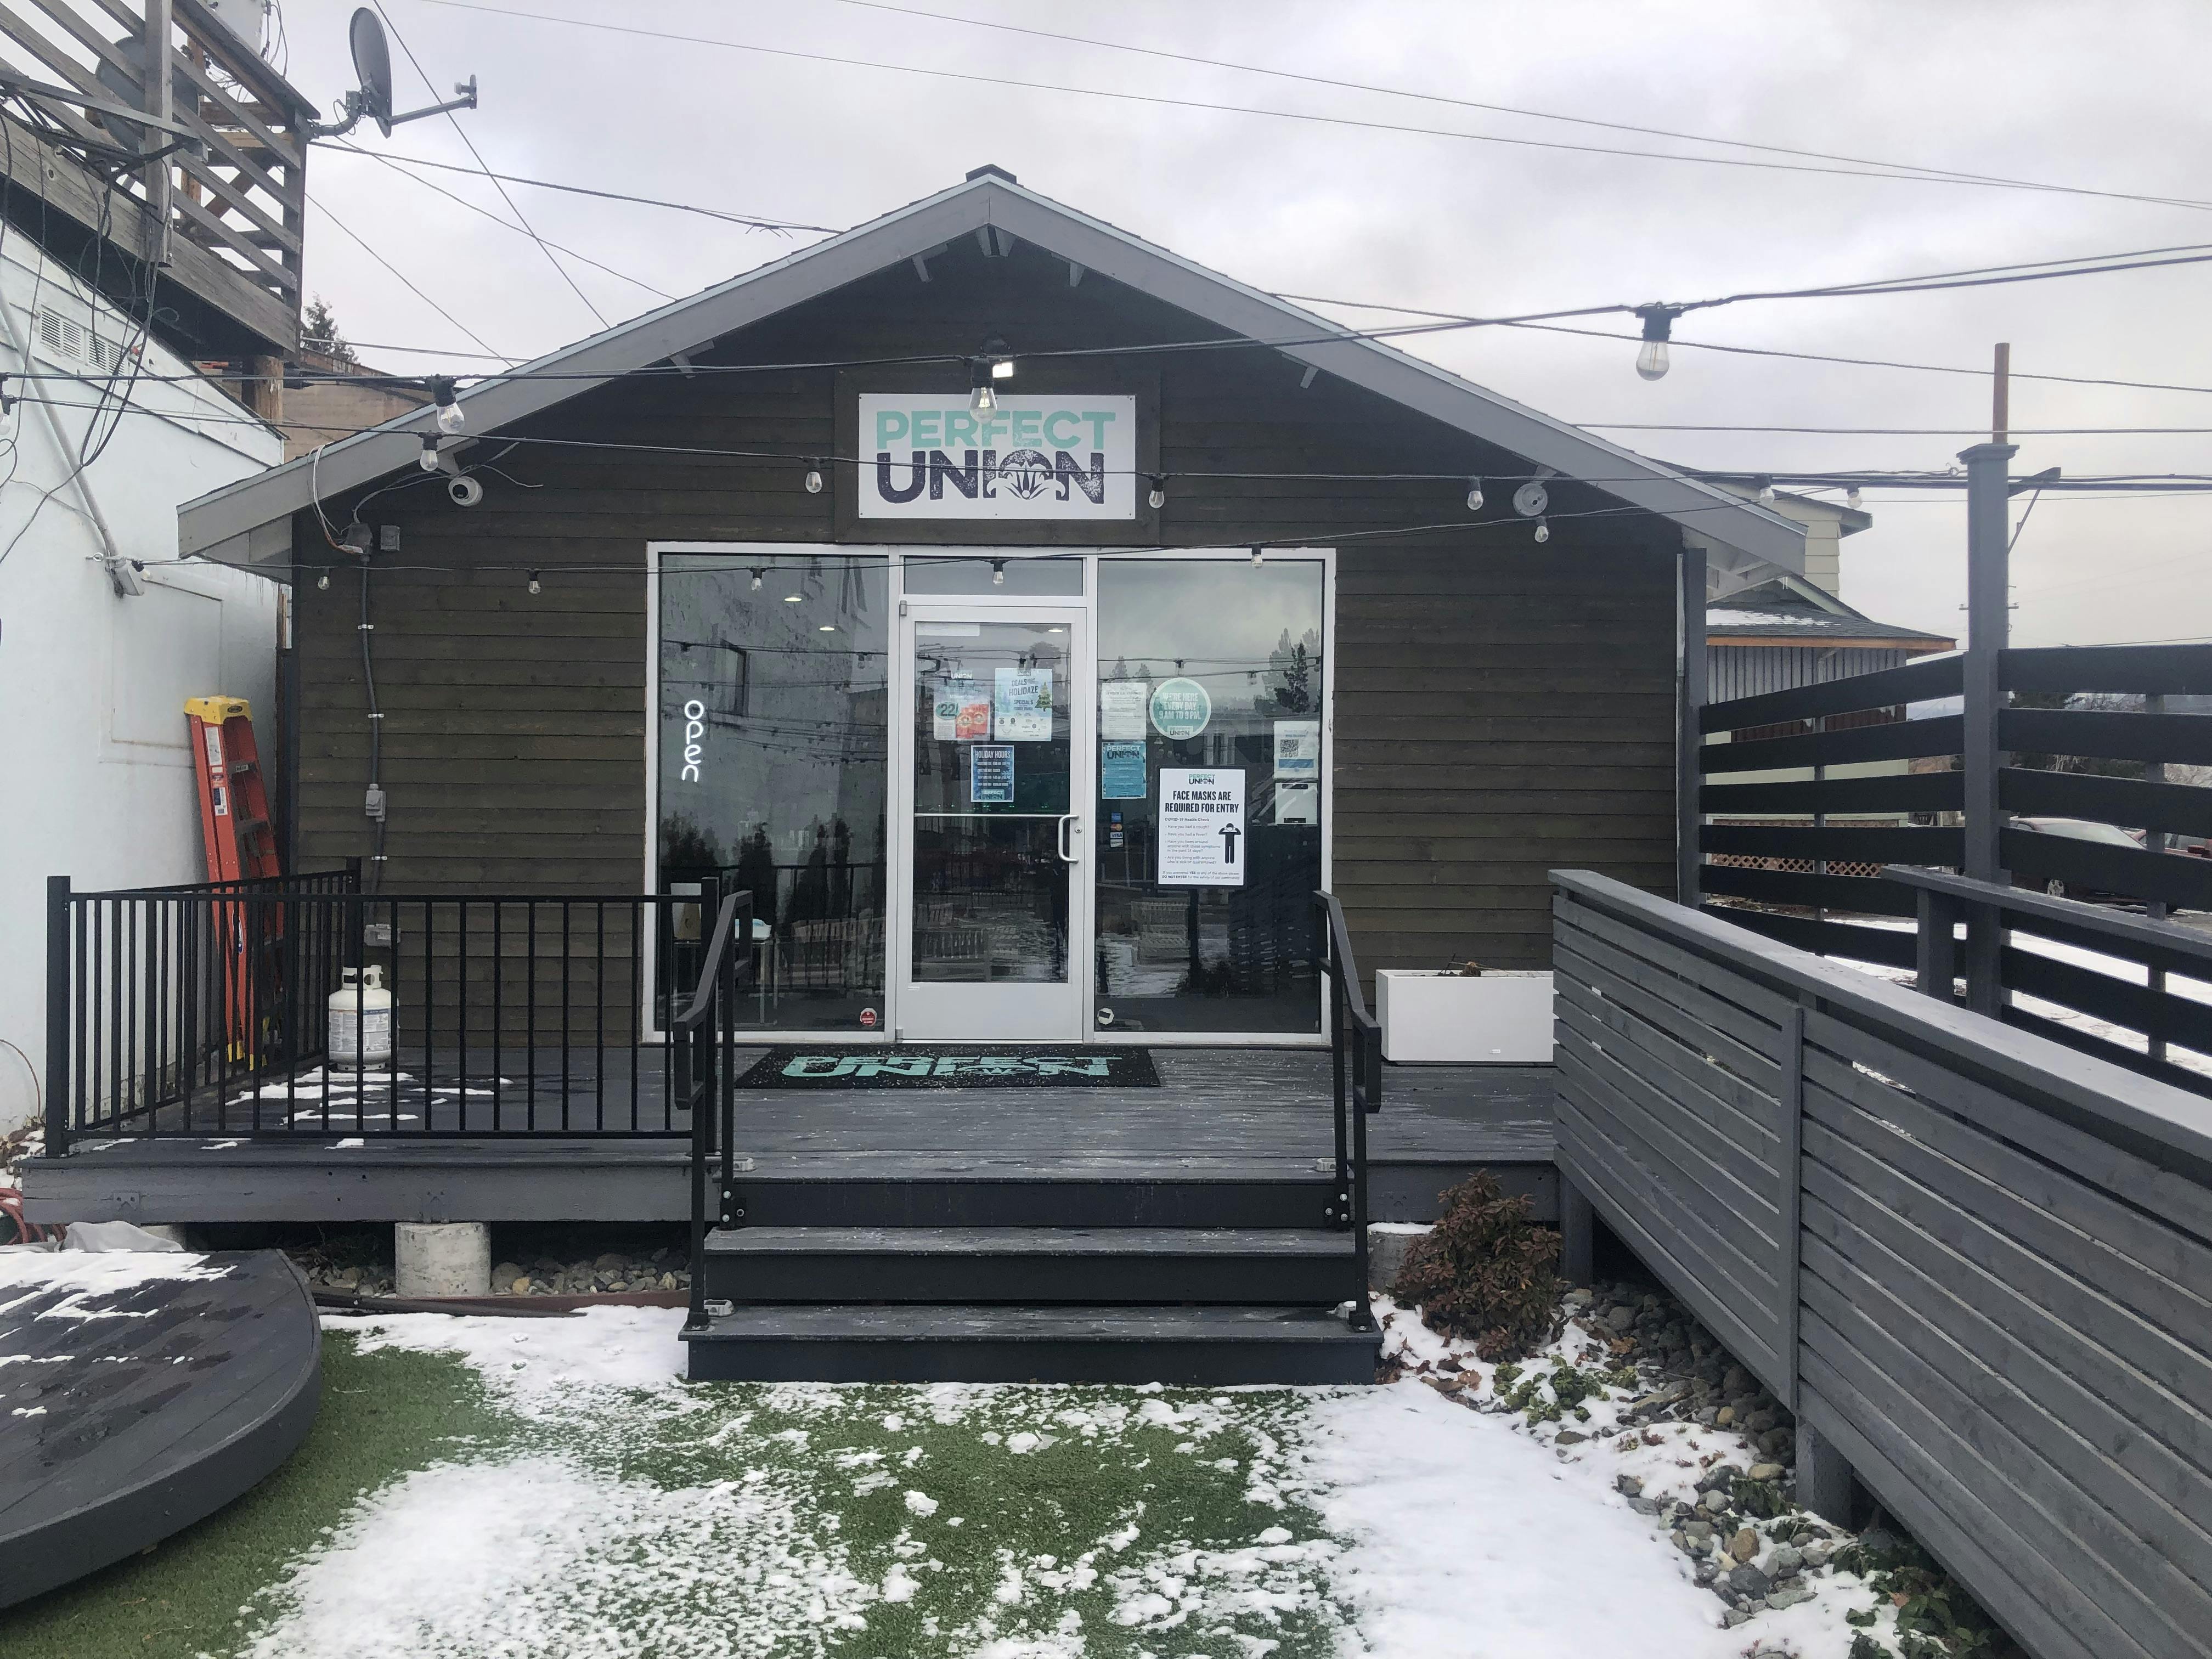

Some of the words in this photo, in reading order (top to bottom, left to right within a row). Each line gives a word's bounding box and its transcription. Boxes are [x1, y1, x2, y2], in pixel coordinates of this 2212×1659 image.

[877, 411, 1116, 450] PERFECT
[877, 449, 1104, 504] UNION
[1009, 686, 1039, 696] HOLIDAZE
[1164, 702, 1183, 710] EVERY
[1184, 702, 1197, 710] DAY
[1107, 751, 1139, 759] UNION
[1173, 791, 1190, 800] FACE
[1192, 791, 1216, 800] MASKS
[1218, 792, 1232, 800] ARE
[1165, 803, 1199, 812] REQUIRED
[1201, 803, 1214, 812] FOR
[1216, 804, 1239, 813] ENTRY
